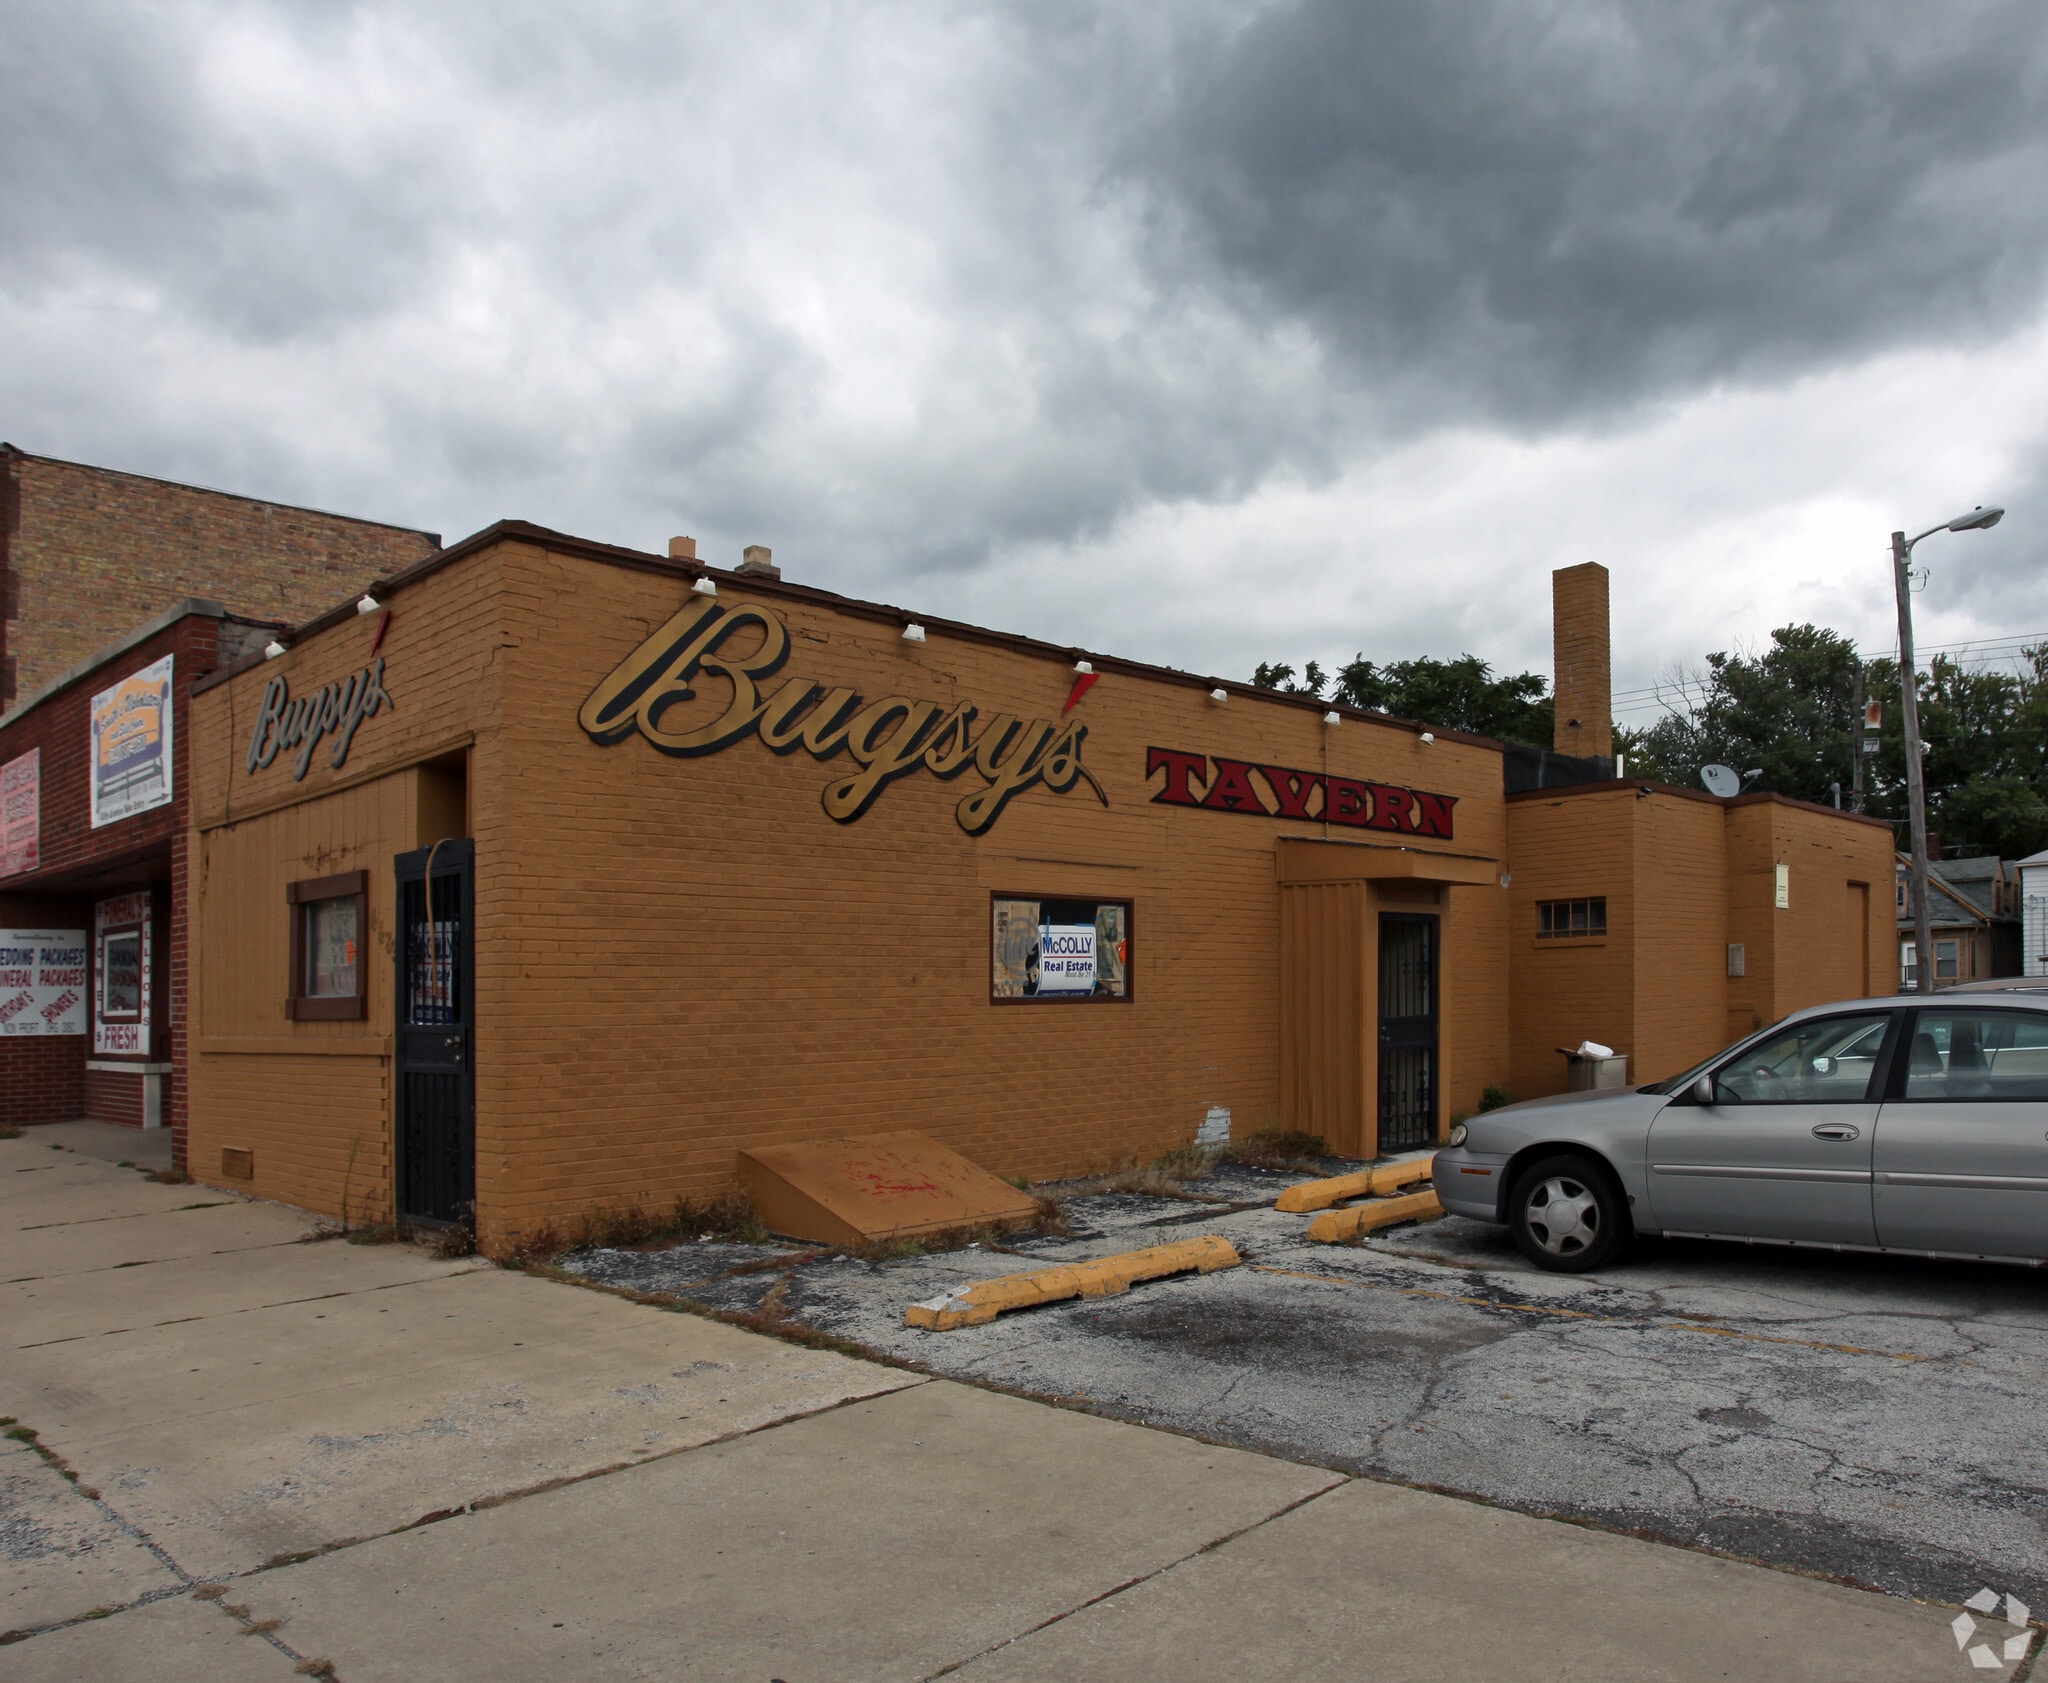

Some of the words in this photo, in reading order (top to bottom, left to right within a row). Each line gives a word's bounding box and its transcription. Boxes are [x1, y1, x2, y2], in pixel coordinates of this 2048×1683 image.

[578, 594, 1110, 837] Bugsy's
[1146, 746, 1459, 840] TAVERN
[1043, 936, 1092, 954] McCOLLY
[0, 948, 34, 966] EDDING
[40, 948, 84, 966] PACKAGES
[1044, 961, 1064, 972] Real
[1066, 961, 1093, 972] Estate
[0, 969, 32, 987] UNERAL
[39, 969, 85, 987] PACKAGES
[104, 1026, 138, 1049] FRESH
